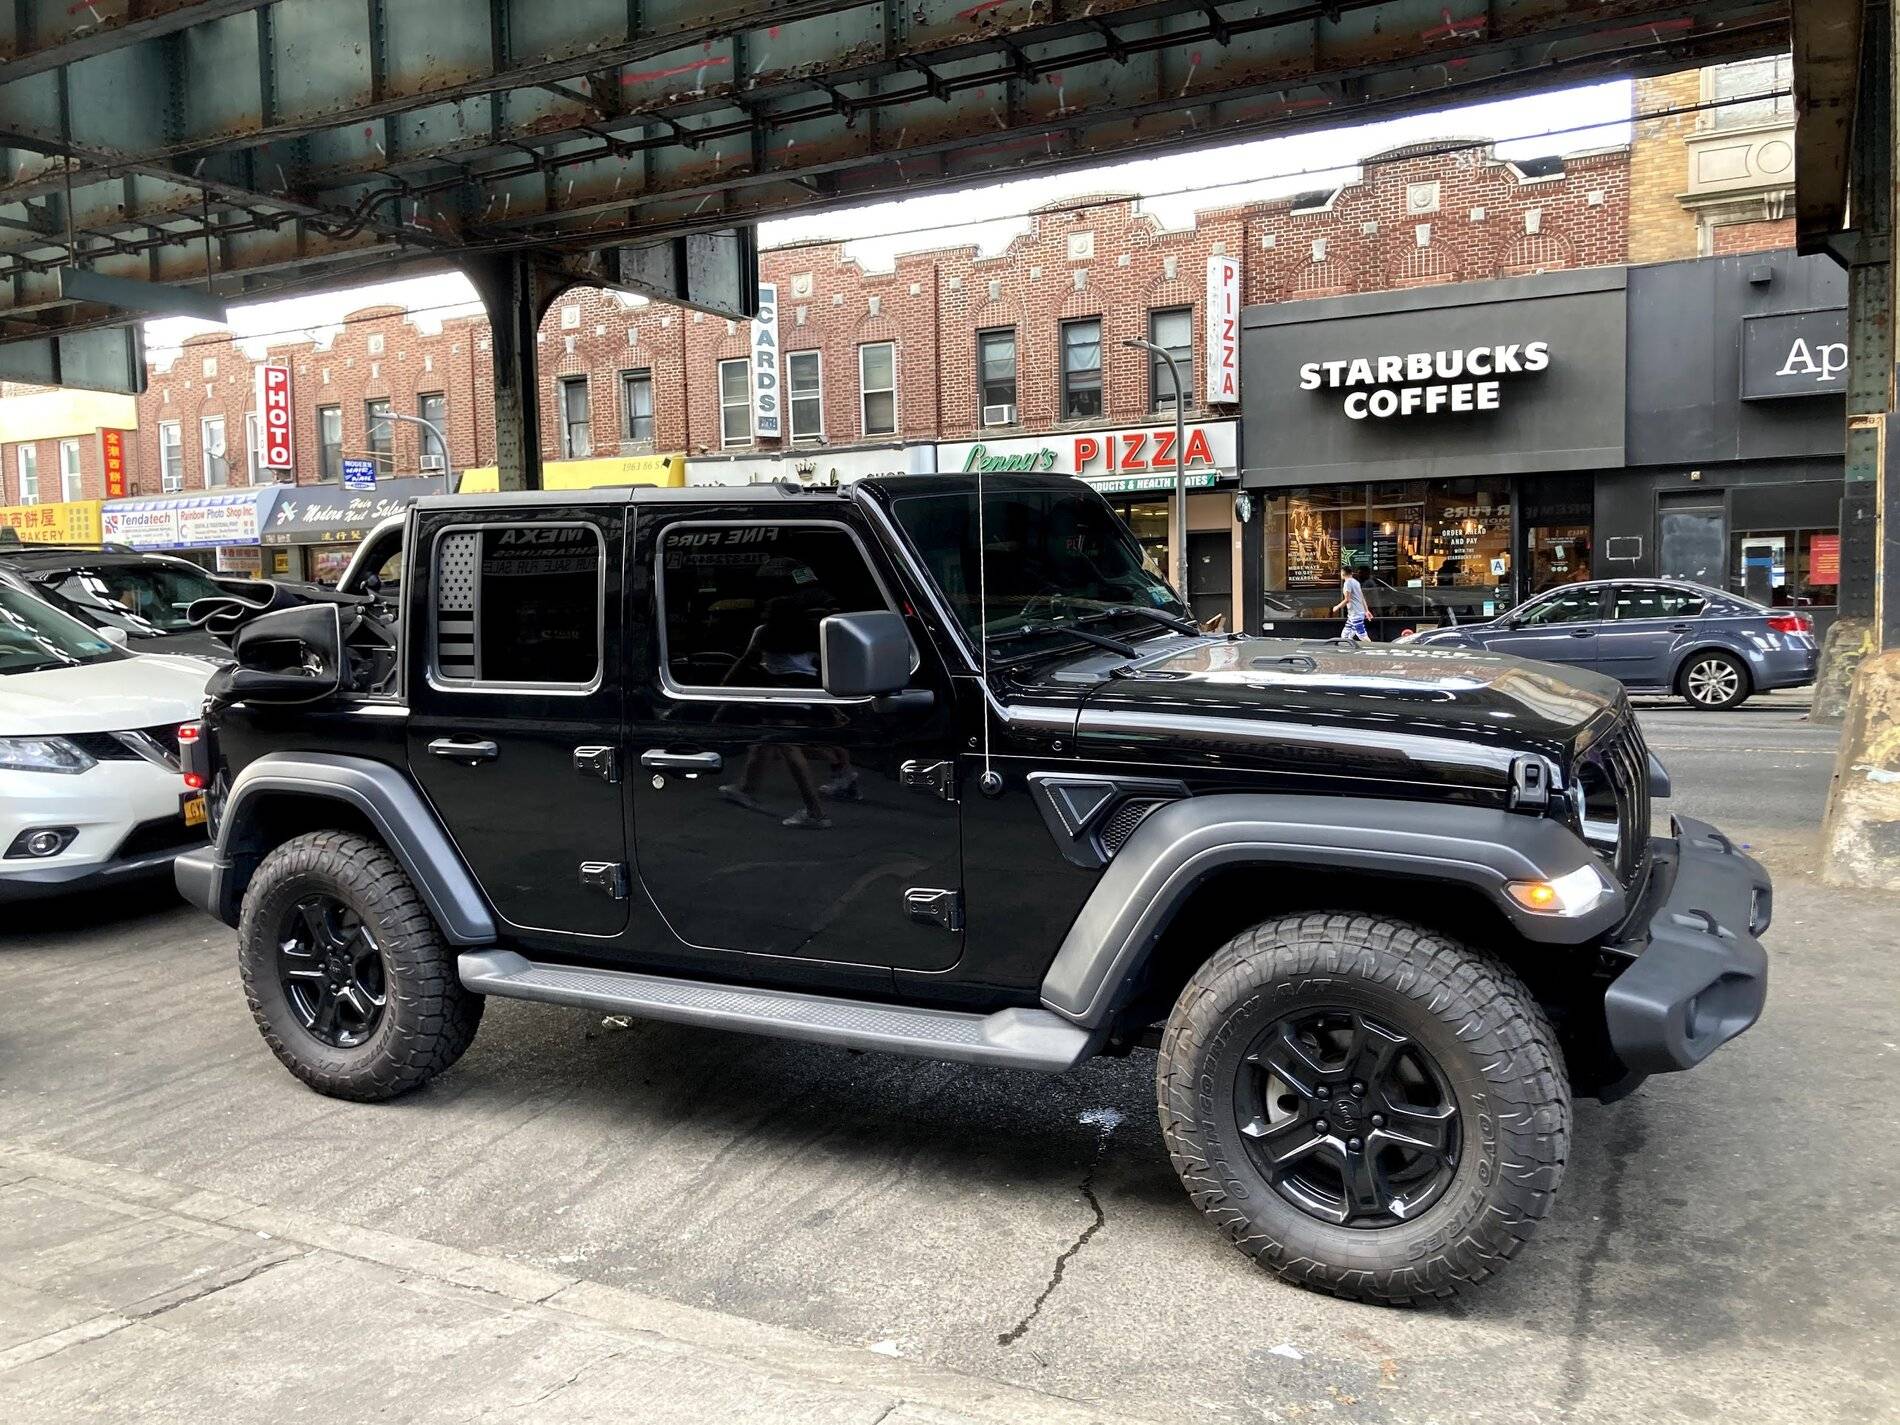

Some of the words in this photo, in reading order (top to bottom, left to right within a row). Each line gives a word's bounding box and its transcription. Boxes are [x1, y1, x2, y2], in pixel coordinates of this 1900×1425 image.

[1223, 265, 1235, 396] PIZZA
[756, 306, 776, 412] CARDS
[1299, 341, 1550, 390] STARBUCKS
[1775, 337, 1849, 381] Ap
[268, 370, 289, 464] PHOTO
[1343, 381, 1500, 420] COFFEE
[962, 443, 1057, 473] Penny's
[1073, 427, 1215, 474] PIZZA
[1128, 479, 1135, 490] &
[1137, 477, 1171, 489] HEALTH
[120, 511, 171, 527] Tendatech
[180, 510, 205, 521] Rainbow
[207, 508, 225, 519] Photo
[226, 506, 242, 520] Shop
[1493, 560, 1503, 572] A
[1201, 1120, 1250, 1200] OPEN
[1471, 1091, 1498, 1188] TOYO
[1408, 1186, 1487, 1262] TIRES
